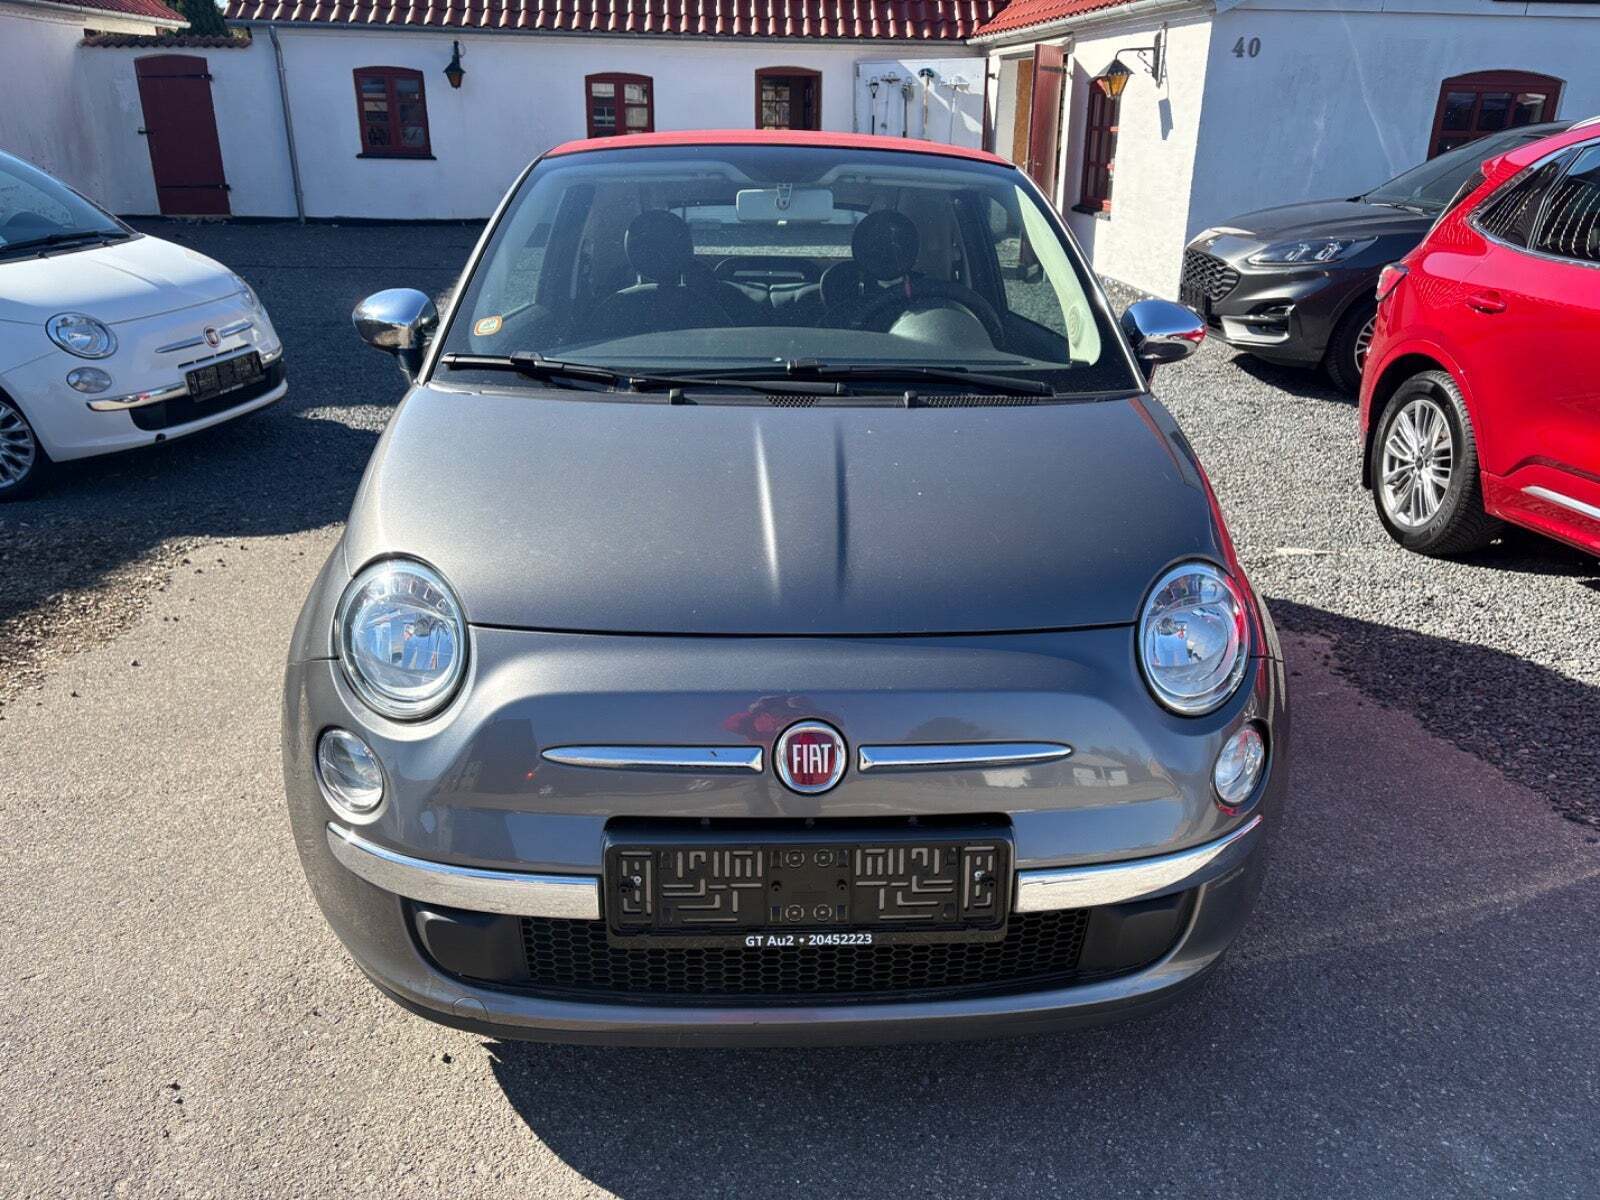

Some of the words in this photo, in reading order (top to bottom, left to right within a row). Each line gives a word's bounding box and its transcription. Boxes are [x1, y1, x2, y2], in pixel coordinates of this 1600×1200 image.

[1231, 36, 1261, 58] 40
[792, 743, 832, 774] FIAT
[745, 935, 764, 947] GT
[767, 935, 795, 947] Au2
[808, 933, 873, 946] 20452223
